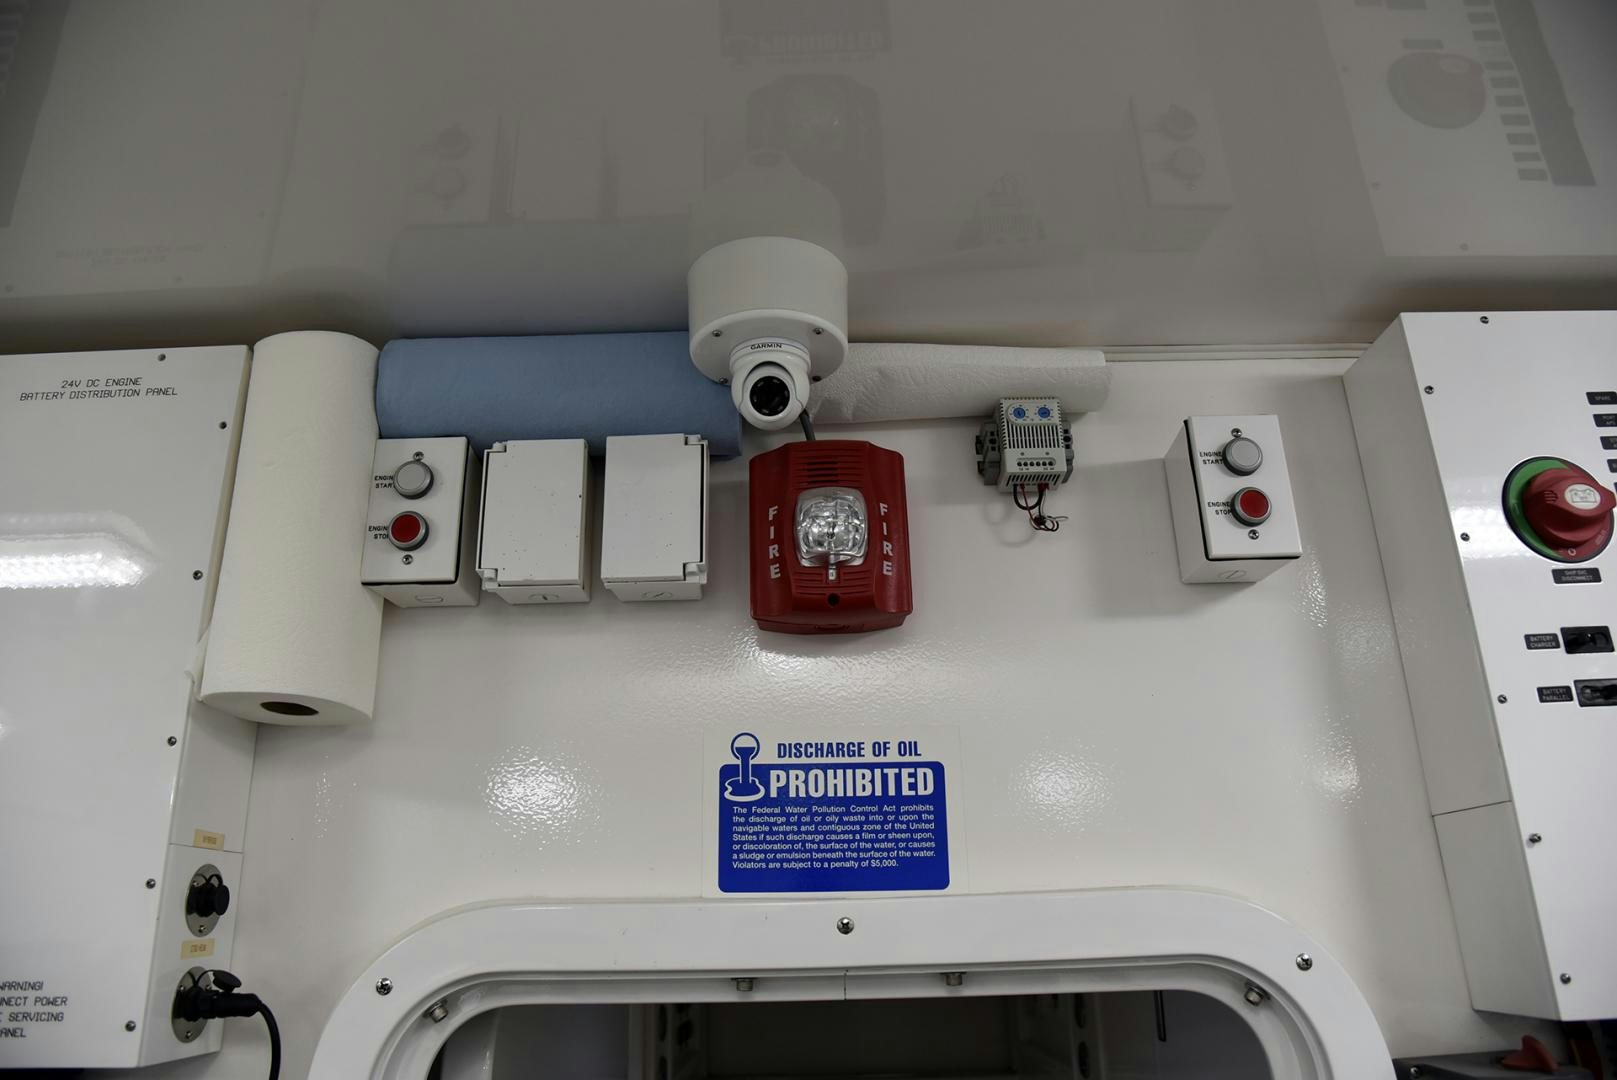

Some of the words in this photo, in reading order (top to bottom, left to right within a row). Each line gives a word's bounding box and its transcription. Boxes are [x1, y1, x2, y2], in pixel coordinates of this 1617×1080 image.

[61, 380, 81, 388] 24V
[86, 379, 100, 388] DC
[105, 377, 143, 387] ENGINE
[20, 391, 65, 401] BATTERY
[69, 389, 140, 399] DISTRIBUTION
[146, 387, 178, 396] PANEL
[768, 506, 781, 579] FIRE
[880, 503, 893, 576] FIRE
[777, 742, 865, 759] DISCHARGE
[872, 741, 890, 757] OF
[898, 741, 922, 756] OIL
[770, 768, 934, 798] PROHIBITED
[901, 804, 934, 812] prohibits
[732, 825, 769, 833] navigable
[739, 852, 765, 860] sludge
[831, 860, 858, 869] penalty
[34, 996, 68, 1006] POWER
[8, 1012, 64, 1022] SERVICING
